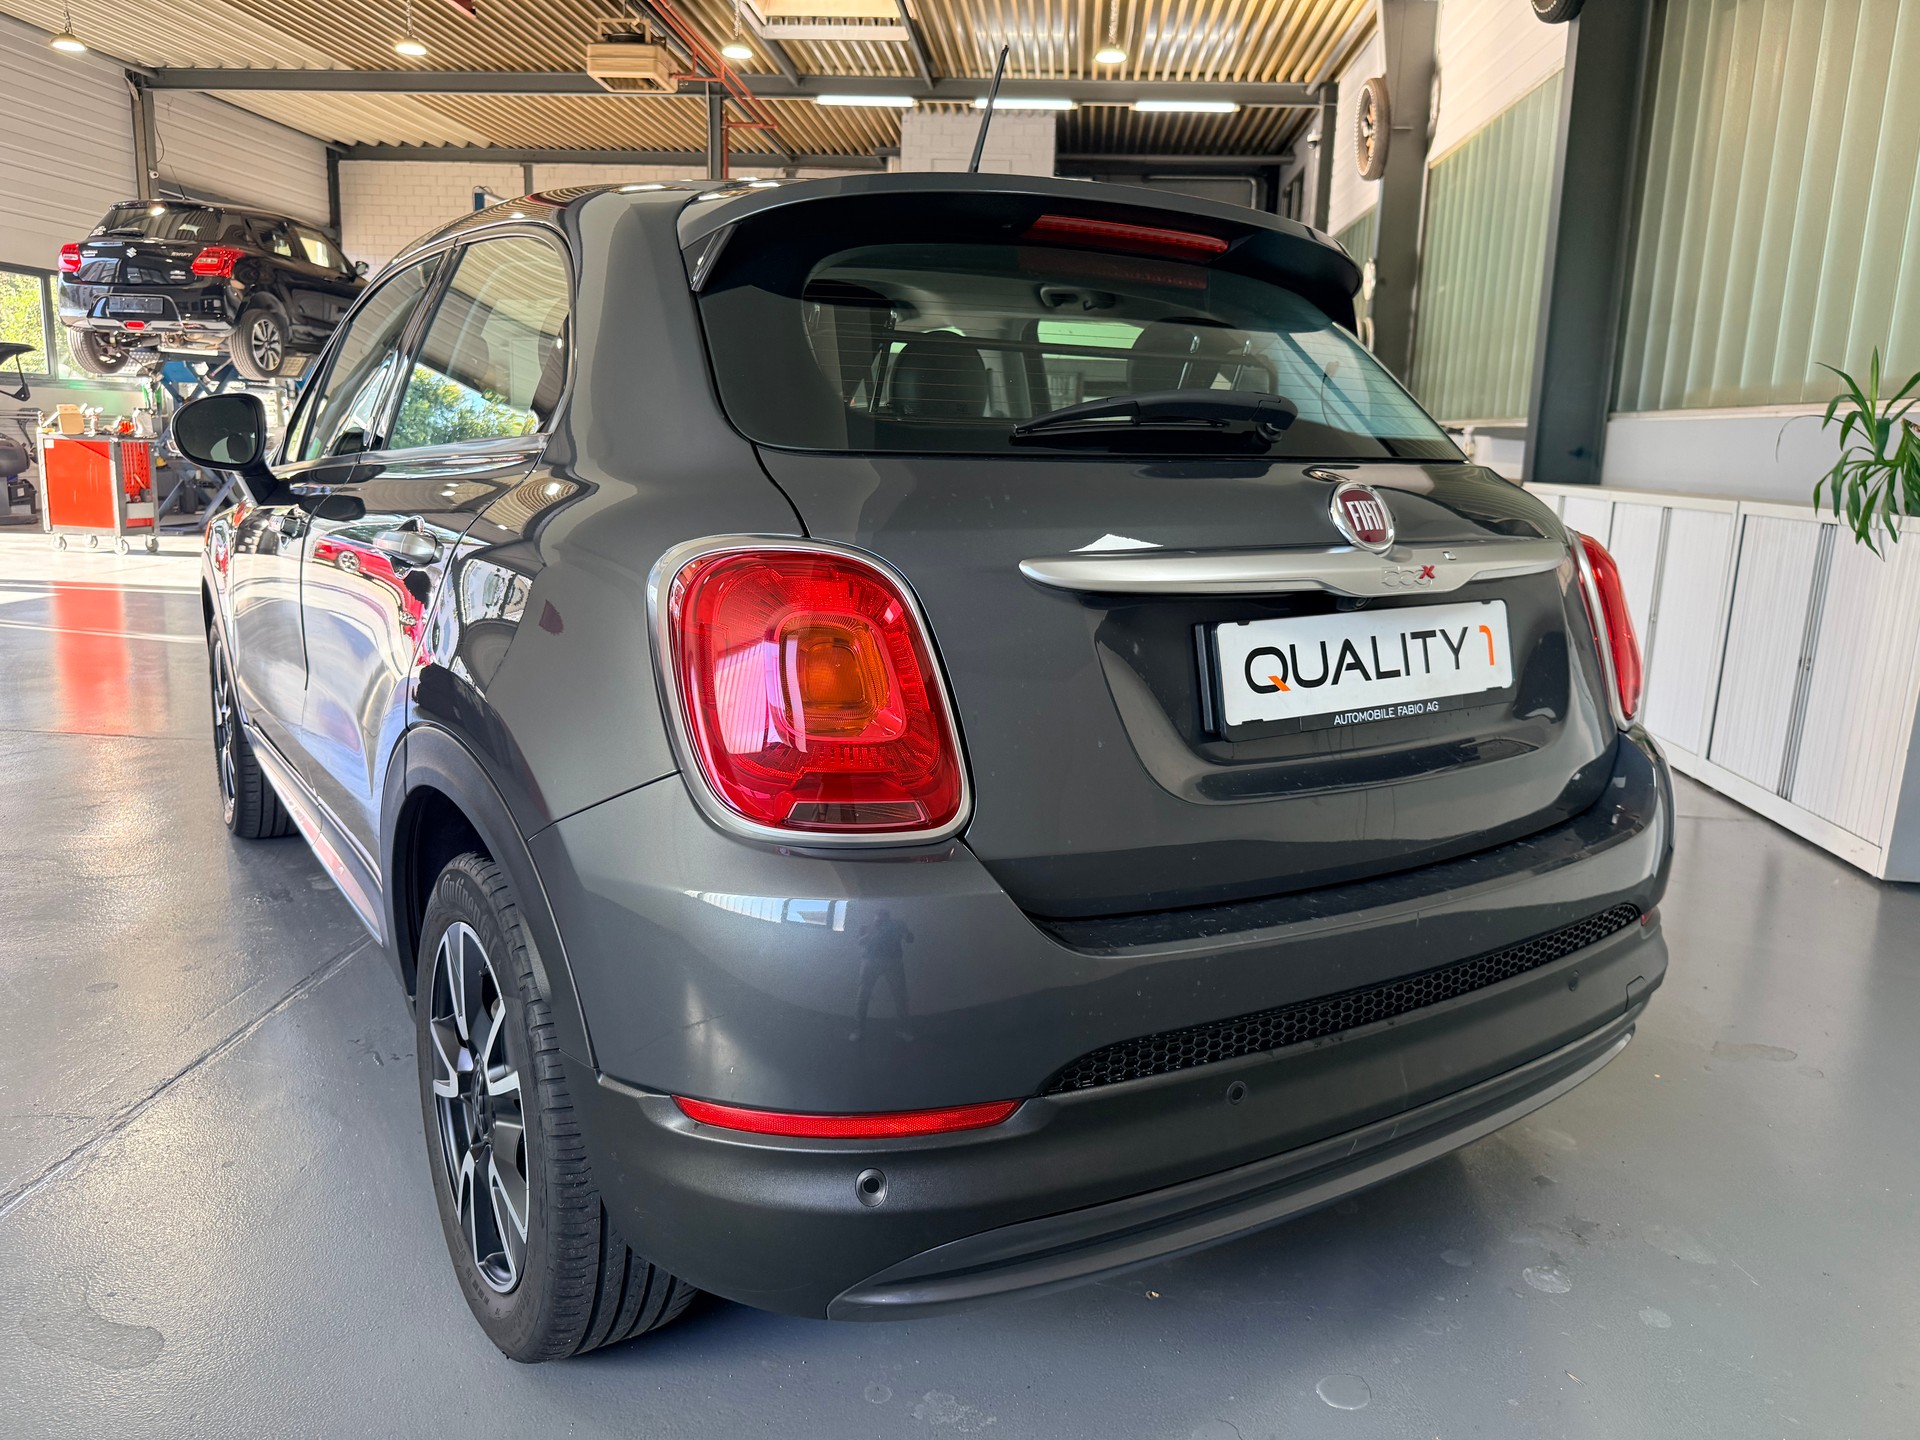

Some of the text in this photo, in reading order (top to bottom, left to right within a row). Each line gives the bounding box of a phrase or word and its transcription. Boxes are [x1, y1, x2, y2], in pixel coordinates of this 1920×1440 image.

[1346, 500, 1384, 531] FIAT
[1333, 701, 1439, 725] AUTOMOBILE FABIO AG
